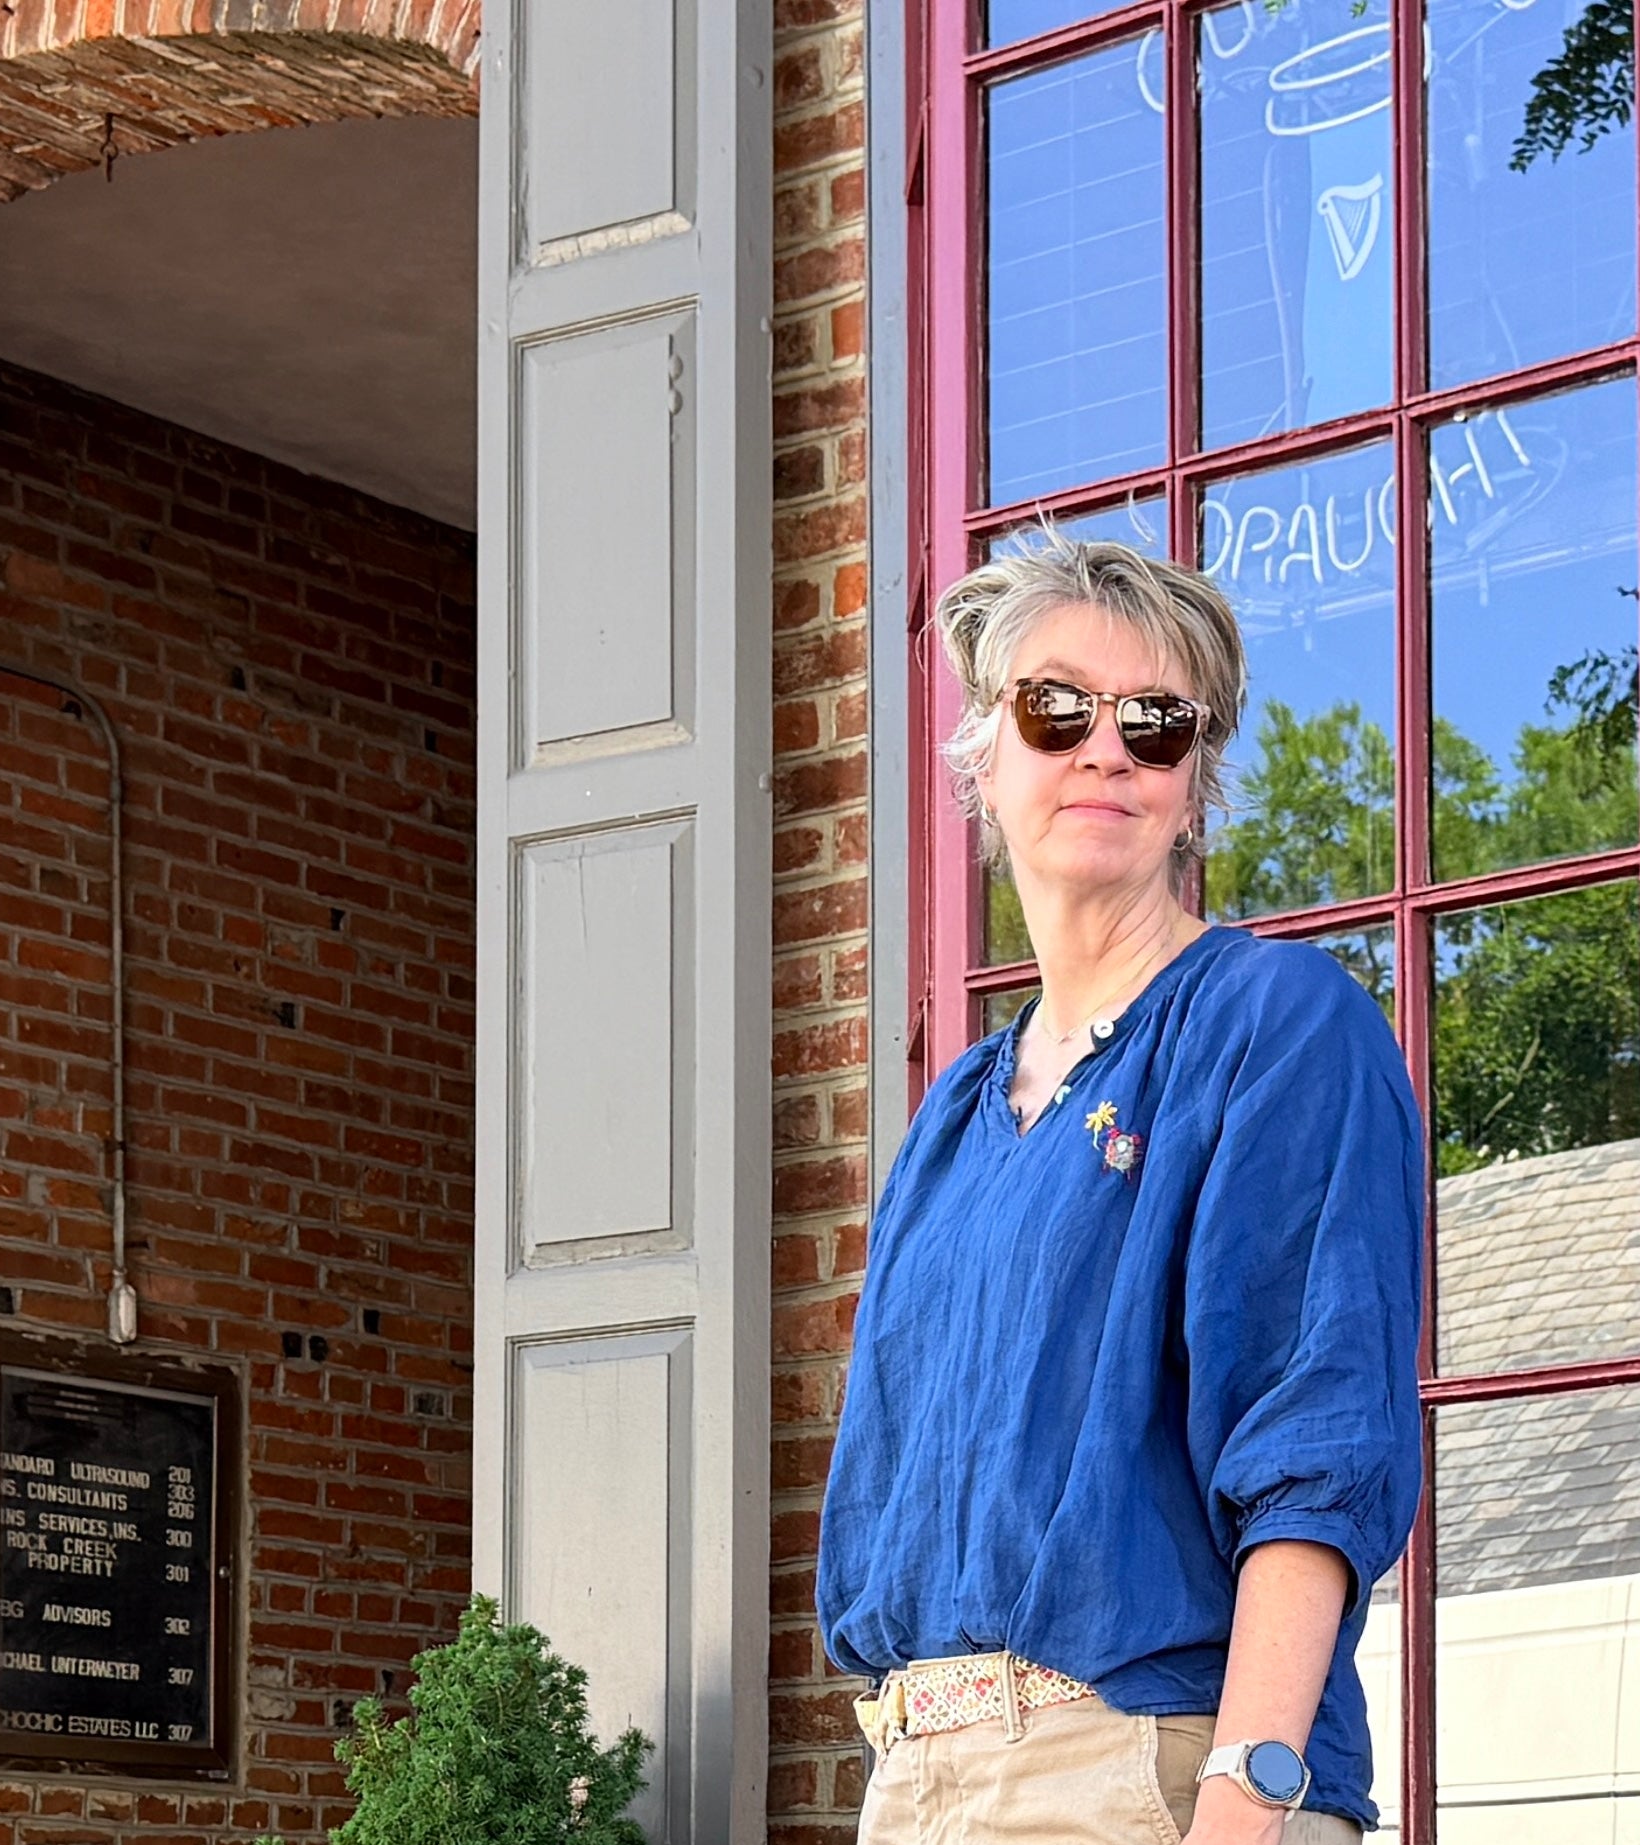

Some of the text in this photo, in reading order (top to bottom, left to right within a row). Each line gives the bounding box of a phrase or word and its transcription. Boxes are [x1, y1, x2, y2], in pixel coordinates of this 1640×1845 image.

[168, 1465, 192, 1484] 201
[26, 1481, 129, 1512] CONSULTANTS
[6, 1530, 118, 1560] ROCK CREEK
[165, 1528, 193, 1548] 300
[27, 1551, 190, 1584] PROPERTY 301
[41, 1602, 112, 1628] ADVISORS
[167, 1666, 194, 1686] 307
[68, 1714, 132, 1738] ESTATES
[134, 1720, 160, 1740] LLC
[167, 1723, 194, 1742] 307
